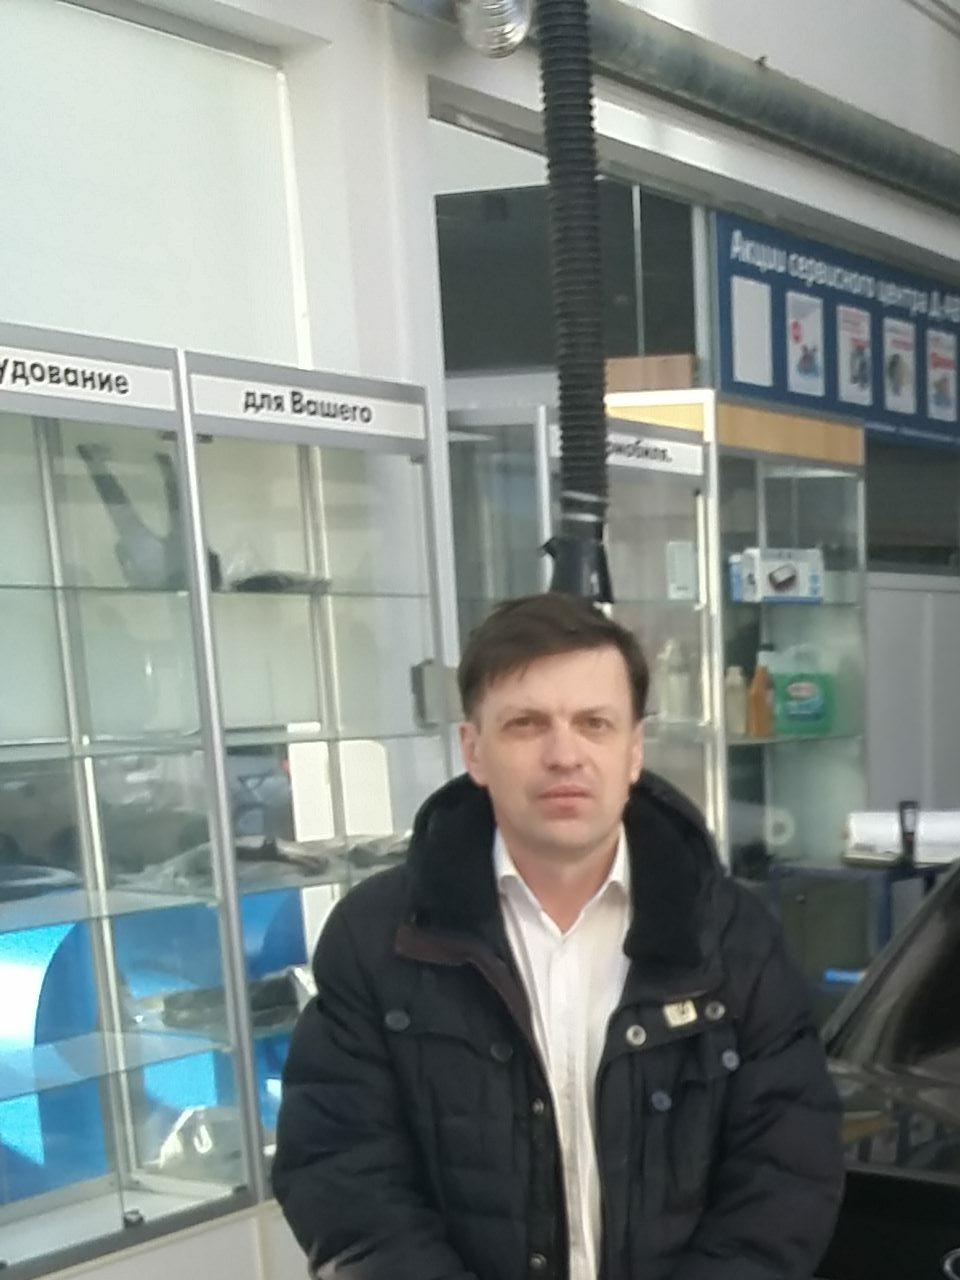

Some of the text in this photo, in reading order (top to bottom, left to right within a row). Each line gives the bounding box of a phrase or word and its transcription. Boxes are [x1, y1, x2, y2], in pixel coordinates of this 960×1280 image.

[730, 229, 787, 274] Акции
[243, 390, 373, 424] для Вашего
